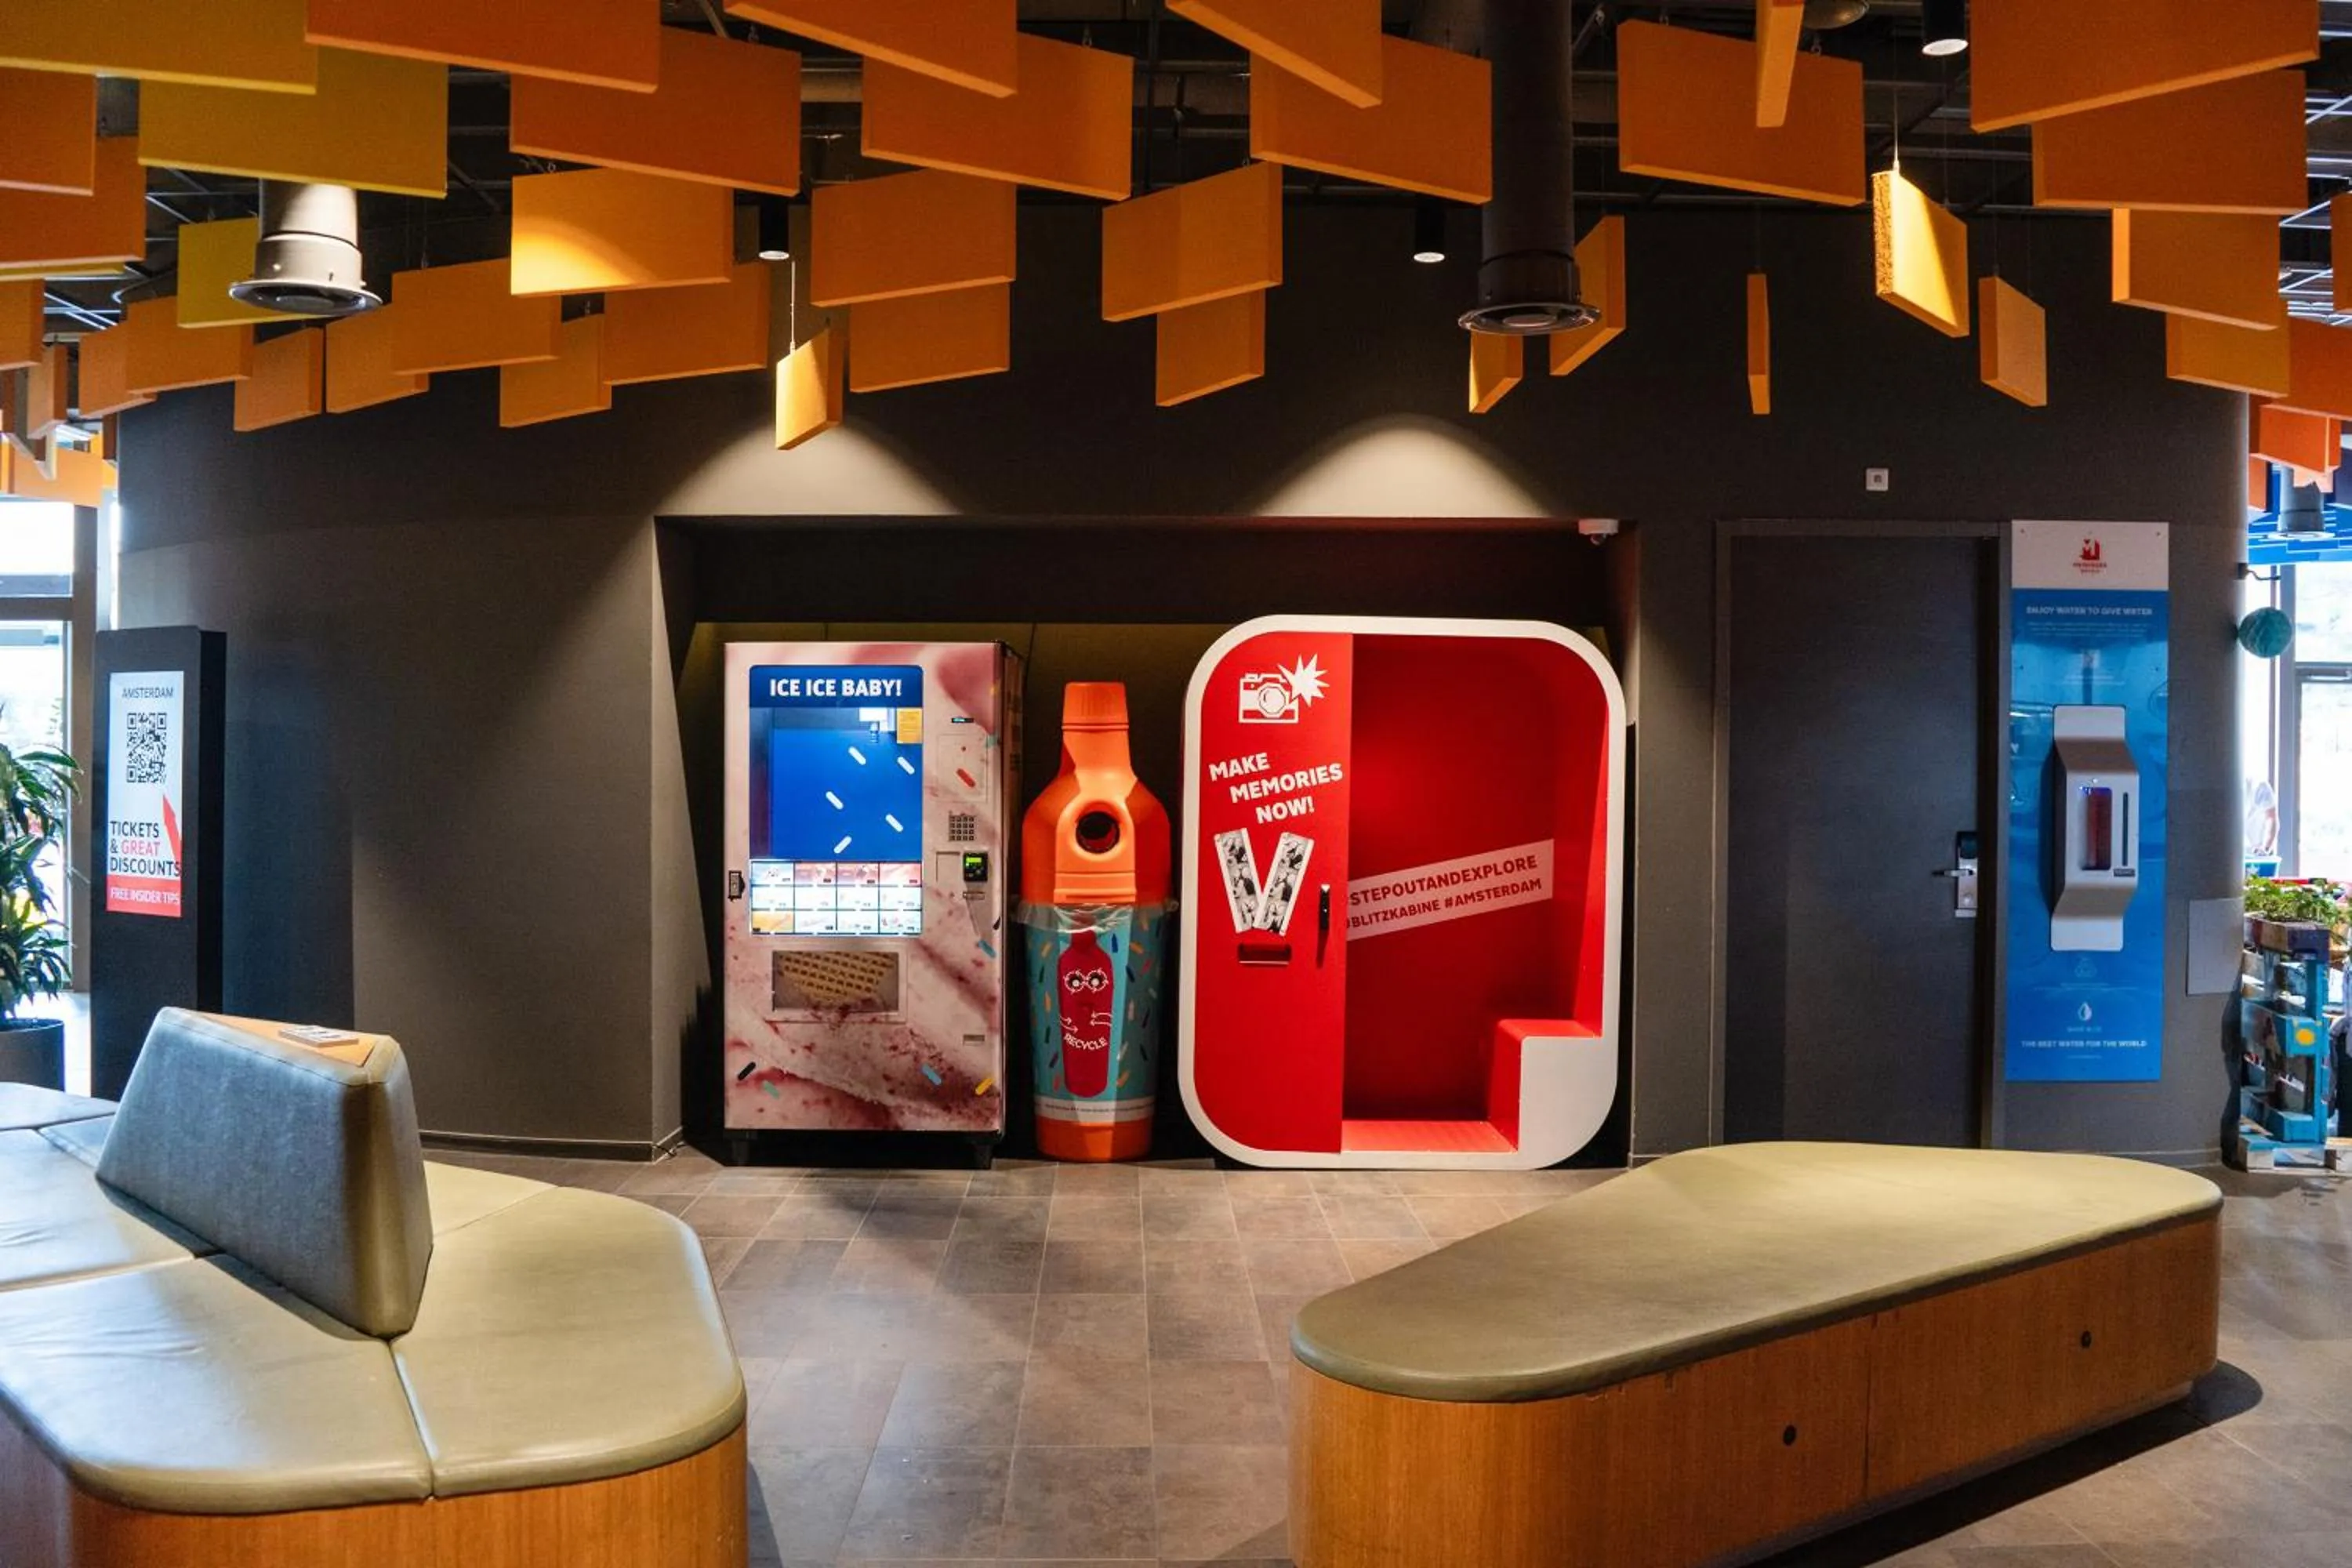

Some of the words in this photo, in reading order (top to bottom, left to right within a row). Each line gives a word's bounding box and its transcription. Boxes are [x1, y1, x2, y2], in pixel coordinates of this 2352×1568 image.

[122, 686, 174, 699] AMSTERDAM
[770, 678, 800, 696] ICE
[806, 678, 837, 696] ICE
[841, 678, 902, 697] BABY!
[1208, 752, 1271, 782] MAKE
[1229, 763, 1343, 804] MEMORIES
[1255, 796, 1315, 824] NOW!
[109, 820, 160, 838] TICKETS
[110, 838, 118, 854] &
[121, 840, 161, 857] GREAT
[109, 857, 181, 877] DISCOUNTS
[1445, 878, 1541, 909] #AMSTERDAM
[1064, 1033, 1108, 1050] RECYCLE
